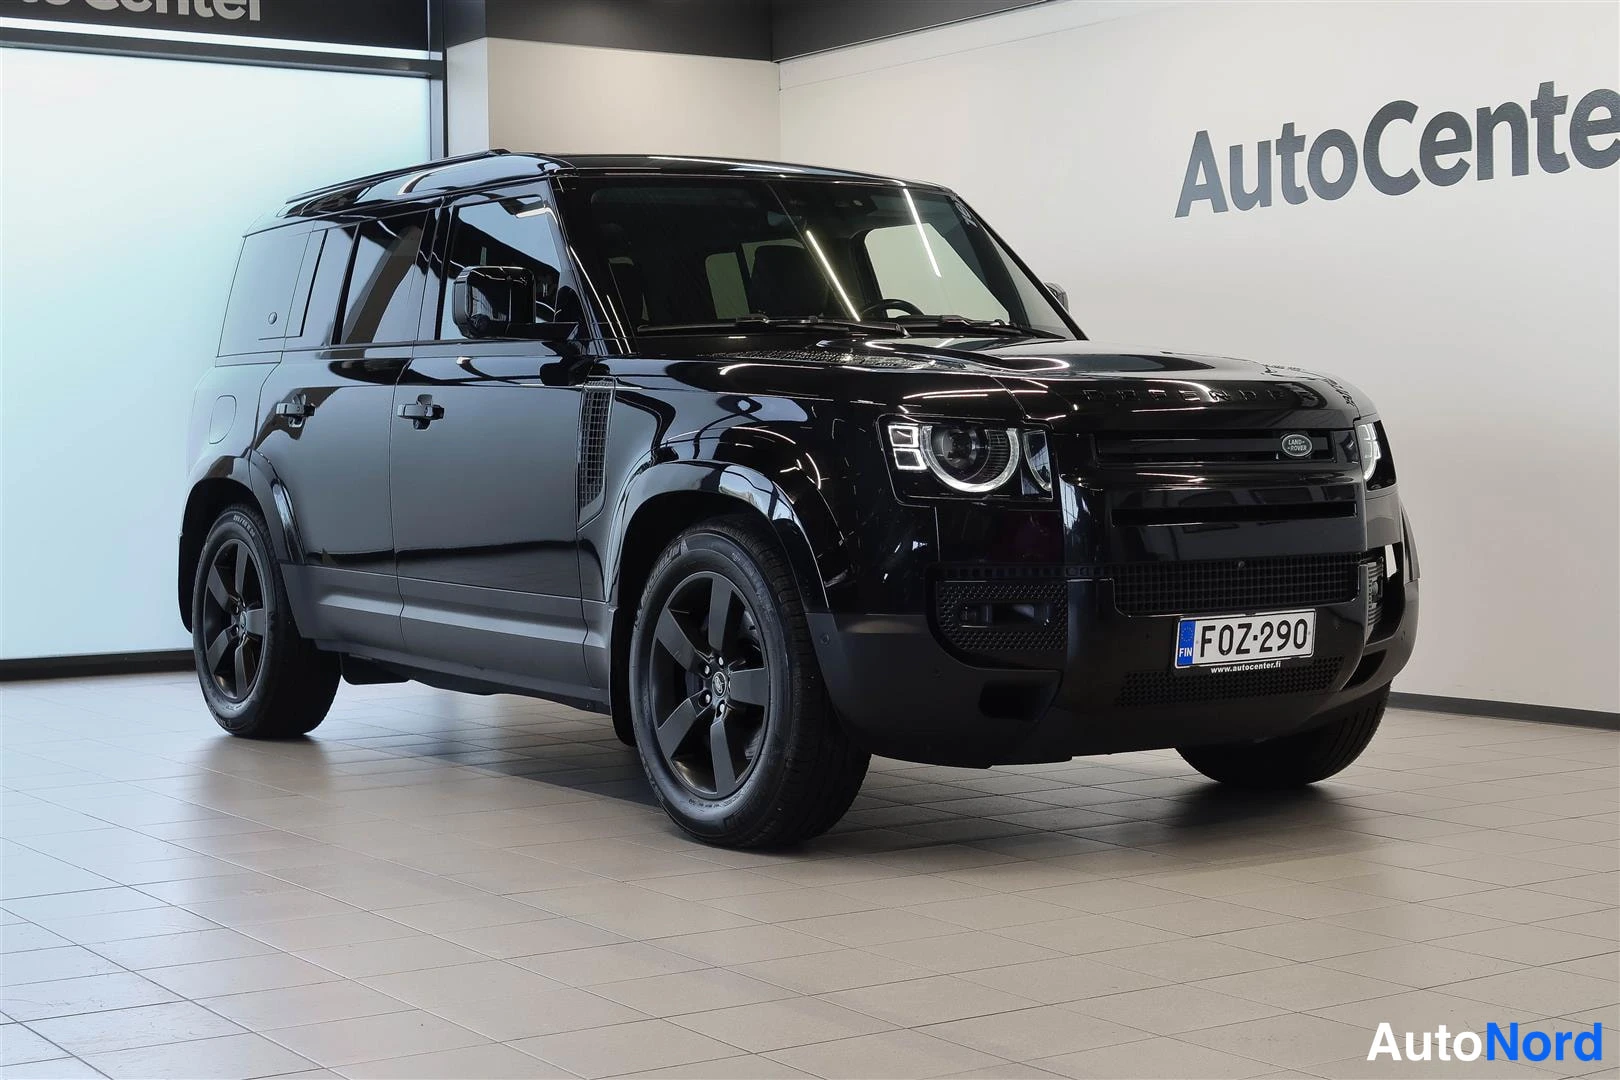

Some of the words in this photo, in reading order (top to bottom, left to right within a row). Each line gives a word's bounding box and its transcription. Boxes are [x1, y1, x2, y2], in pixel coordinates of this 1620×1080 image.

[1174, 80, 1620, 218] AutoCente
[1200, 618, 1308, 658] FOZ-290
[1179, 647, 1193, 657] FIN
[1211, 661, 1281, 674] www.autocenter.fi
